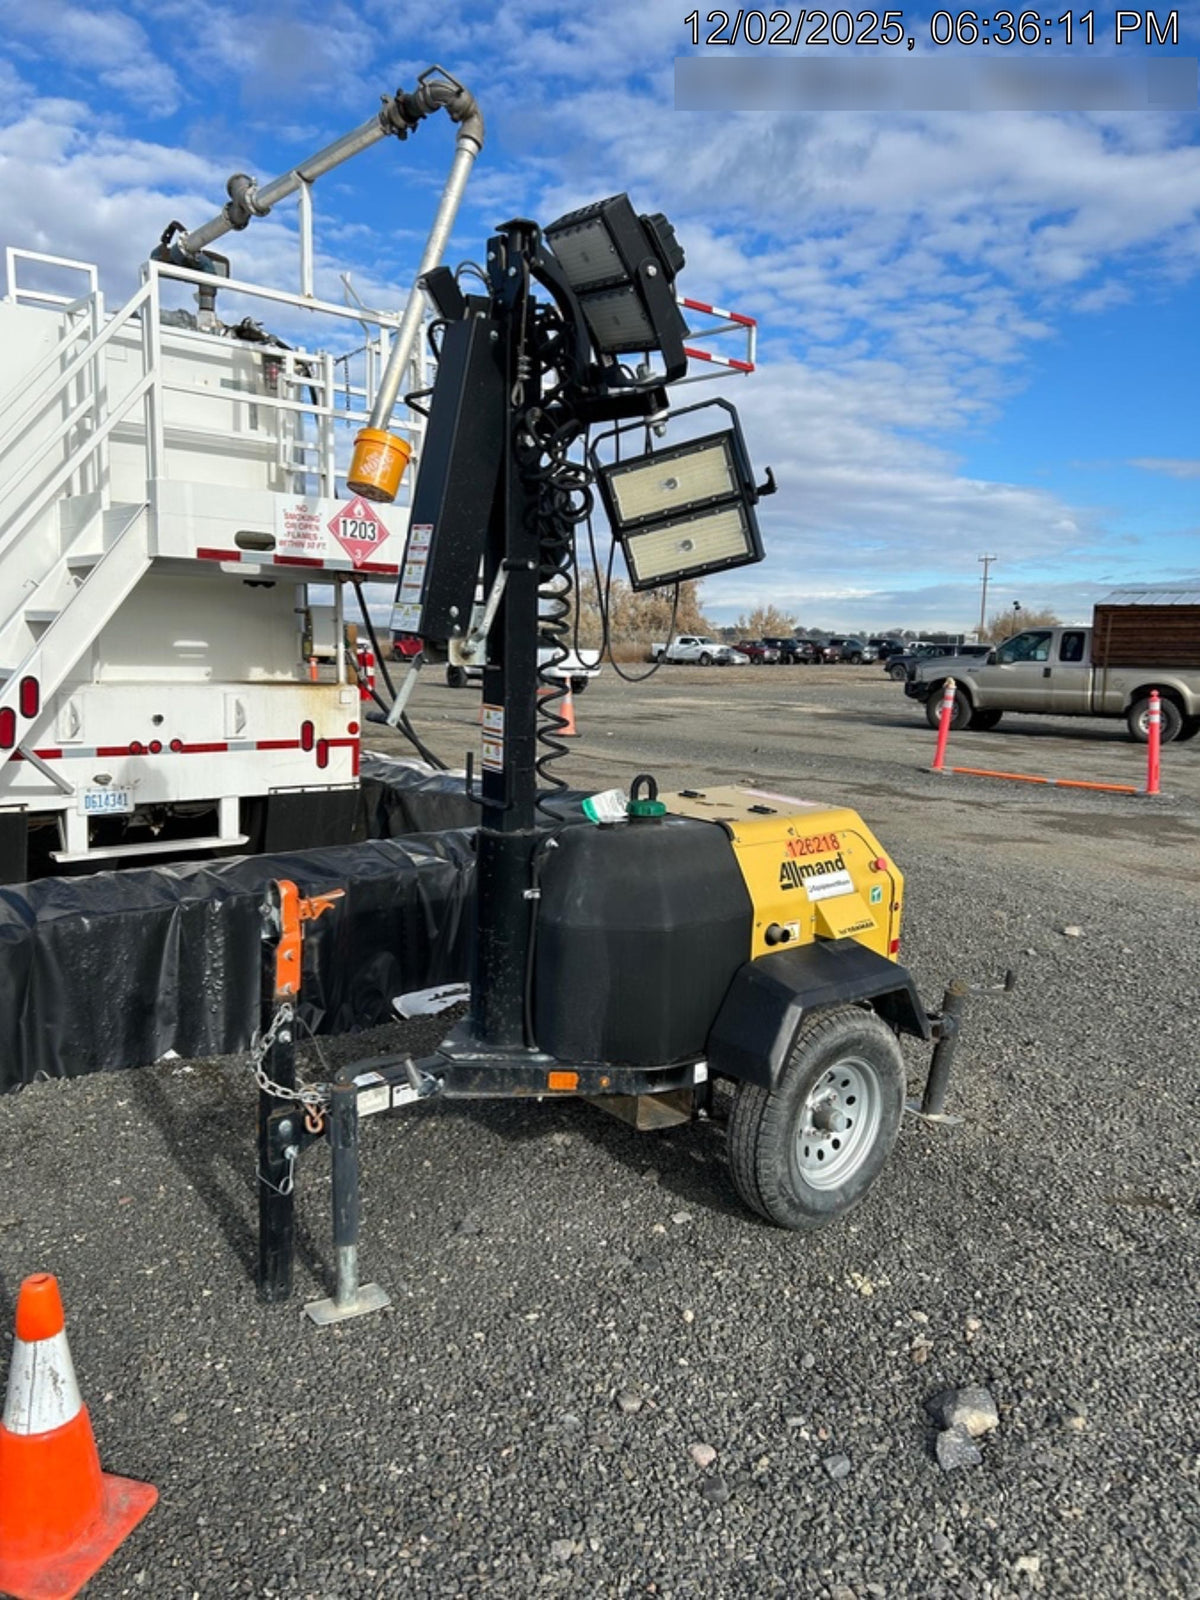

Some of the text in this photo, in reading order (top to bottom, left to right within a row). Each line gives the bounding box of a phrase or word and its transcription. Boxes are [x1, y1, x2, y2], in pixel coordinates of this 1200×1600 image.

[295, 504, 309, 513] NO
[341, 519, 376, 541] 1203
[354, 549, 362, 558] 3
[779, 851, 846, 888] Allmand
